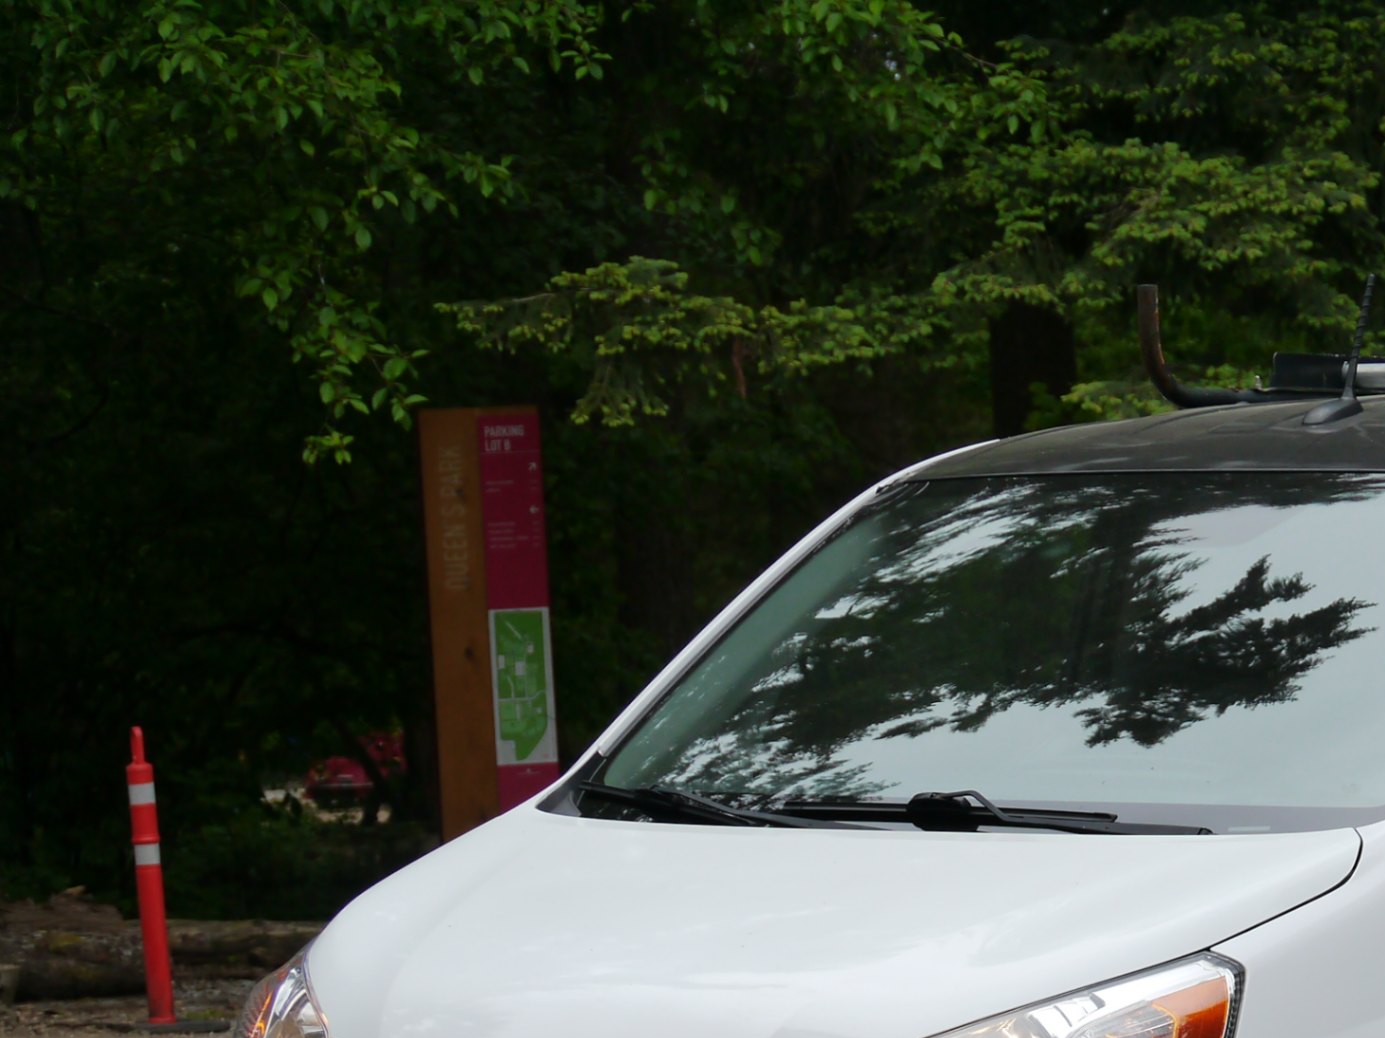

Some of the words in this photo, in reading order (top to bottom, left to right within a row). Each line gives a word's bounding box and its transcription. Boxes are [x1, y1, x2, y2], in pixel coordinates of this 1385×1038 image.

[484, 424, 525, 437] PARKING
[485, 439, 501, 452] LOT
[438, 446, 464, 497] PARK
[441, 503, 469, 591] QUEEN'S
